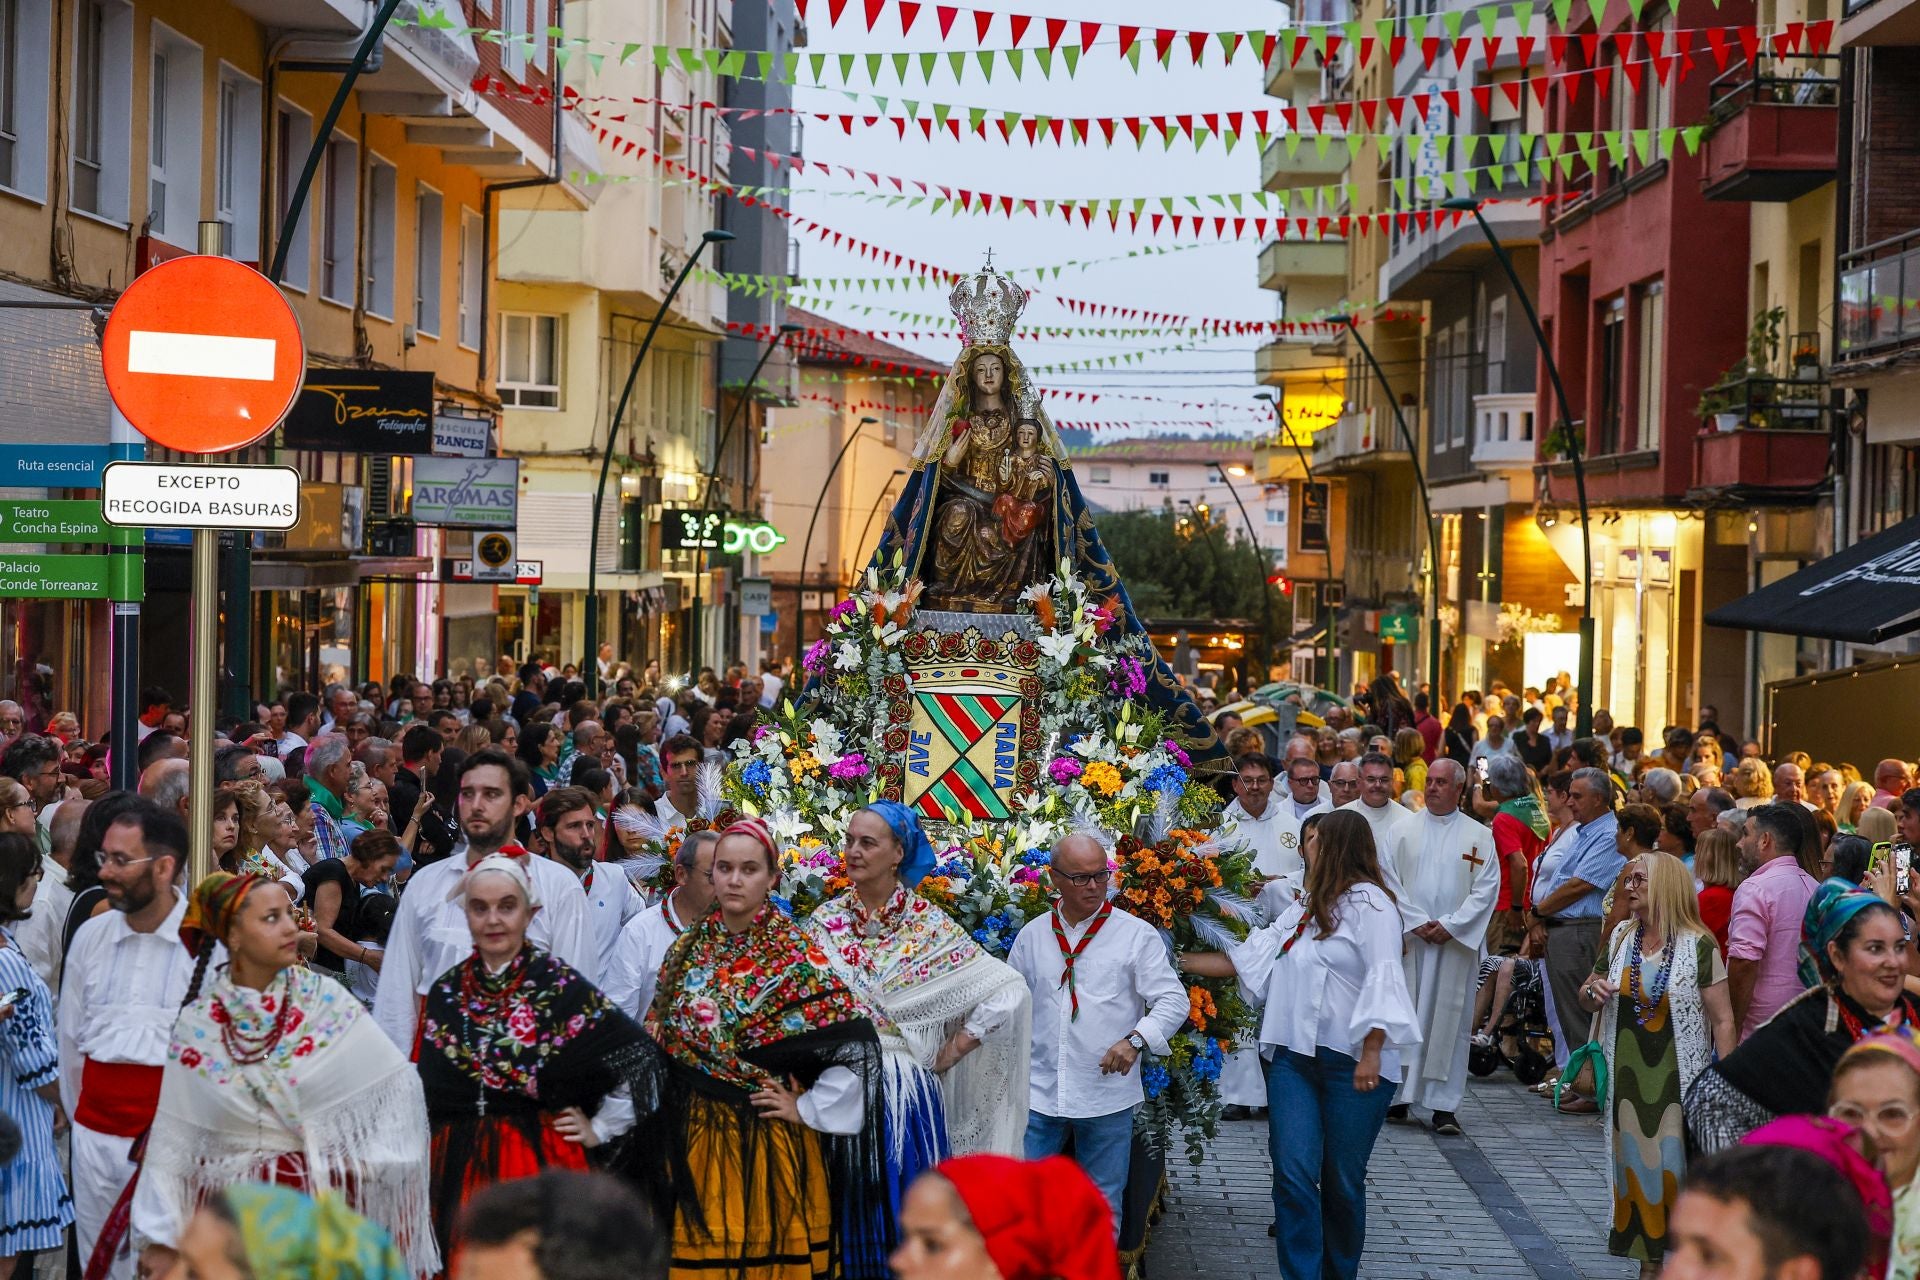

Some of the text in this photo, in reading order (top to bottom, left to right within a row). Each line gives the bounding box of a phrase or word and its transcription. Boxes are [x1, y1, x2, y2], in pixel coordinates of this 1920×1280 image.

[377, 418, 427, 434] Fotógrafos
[434, 434, 485, 450] RANCES
[18, 459, 94, 471] Ruta esencial
[158, 475, 240, 490] EXCEPTO
[416, 486, 514, 507] AROMAS
[13, 506, 49, 518] Teatro
[109, 499, 293, 517] RECOGIDA BASURAS
[13, 522, 98, 536] Concha Espina
[0, 561, 41, 573] Palacio
[0, 579, 98, 591] Conde Torreanaz
[909, 730, 932, 777] AVE
[992, 722, 1017, 789] MARIA
